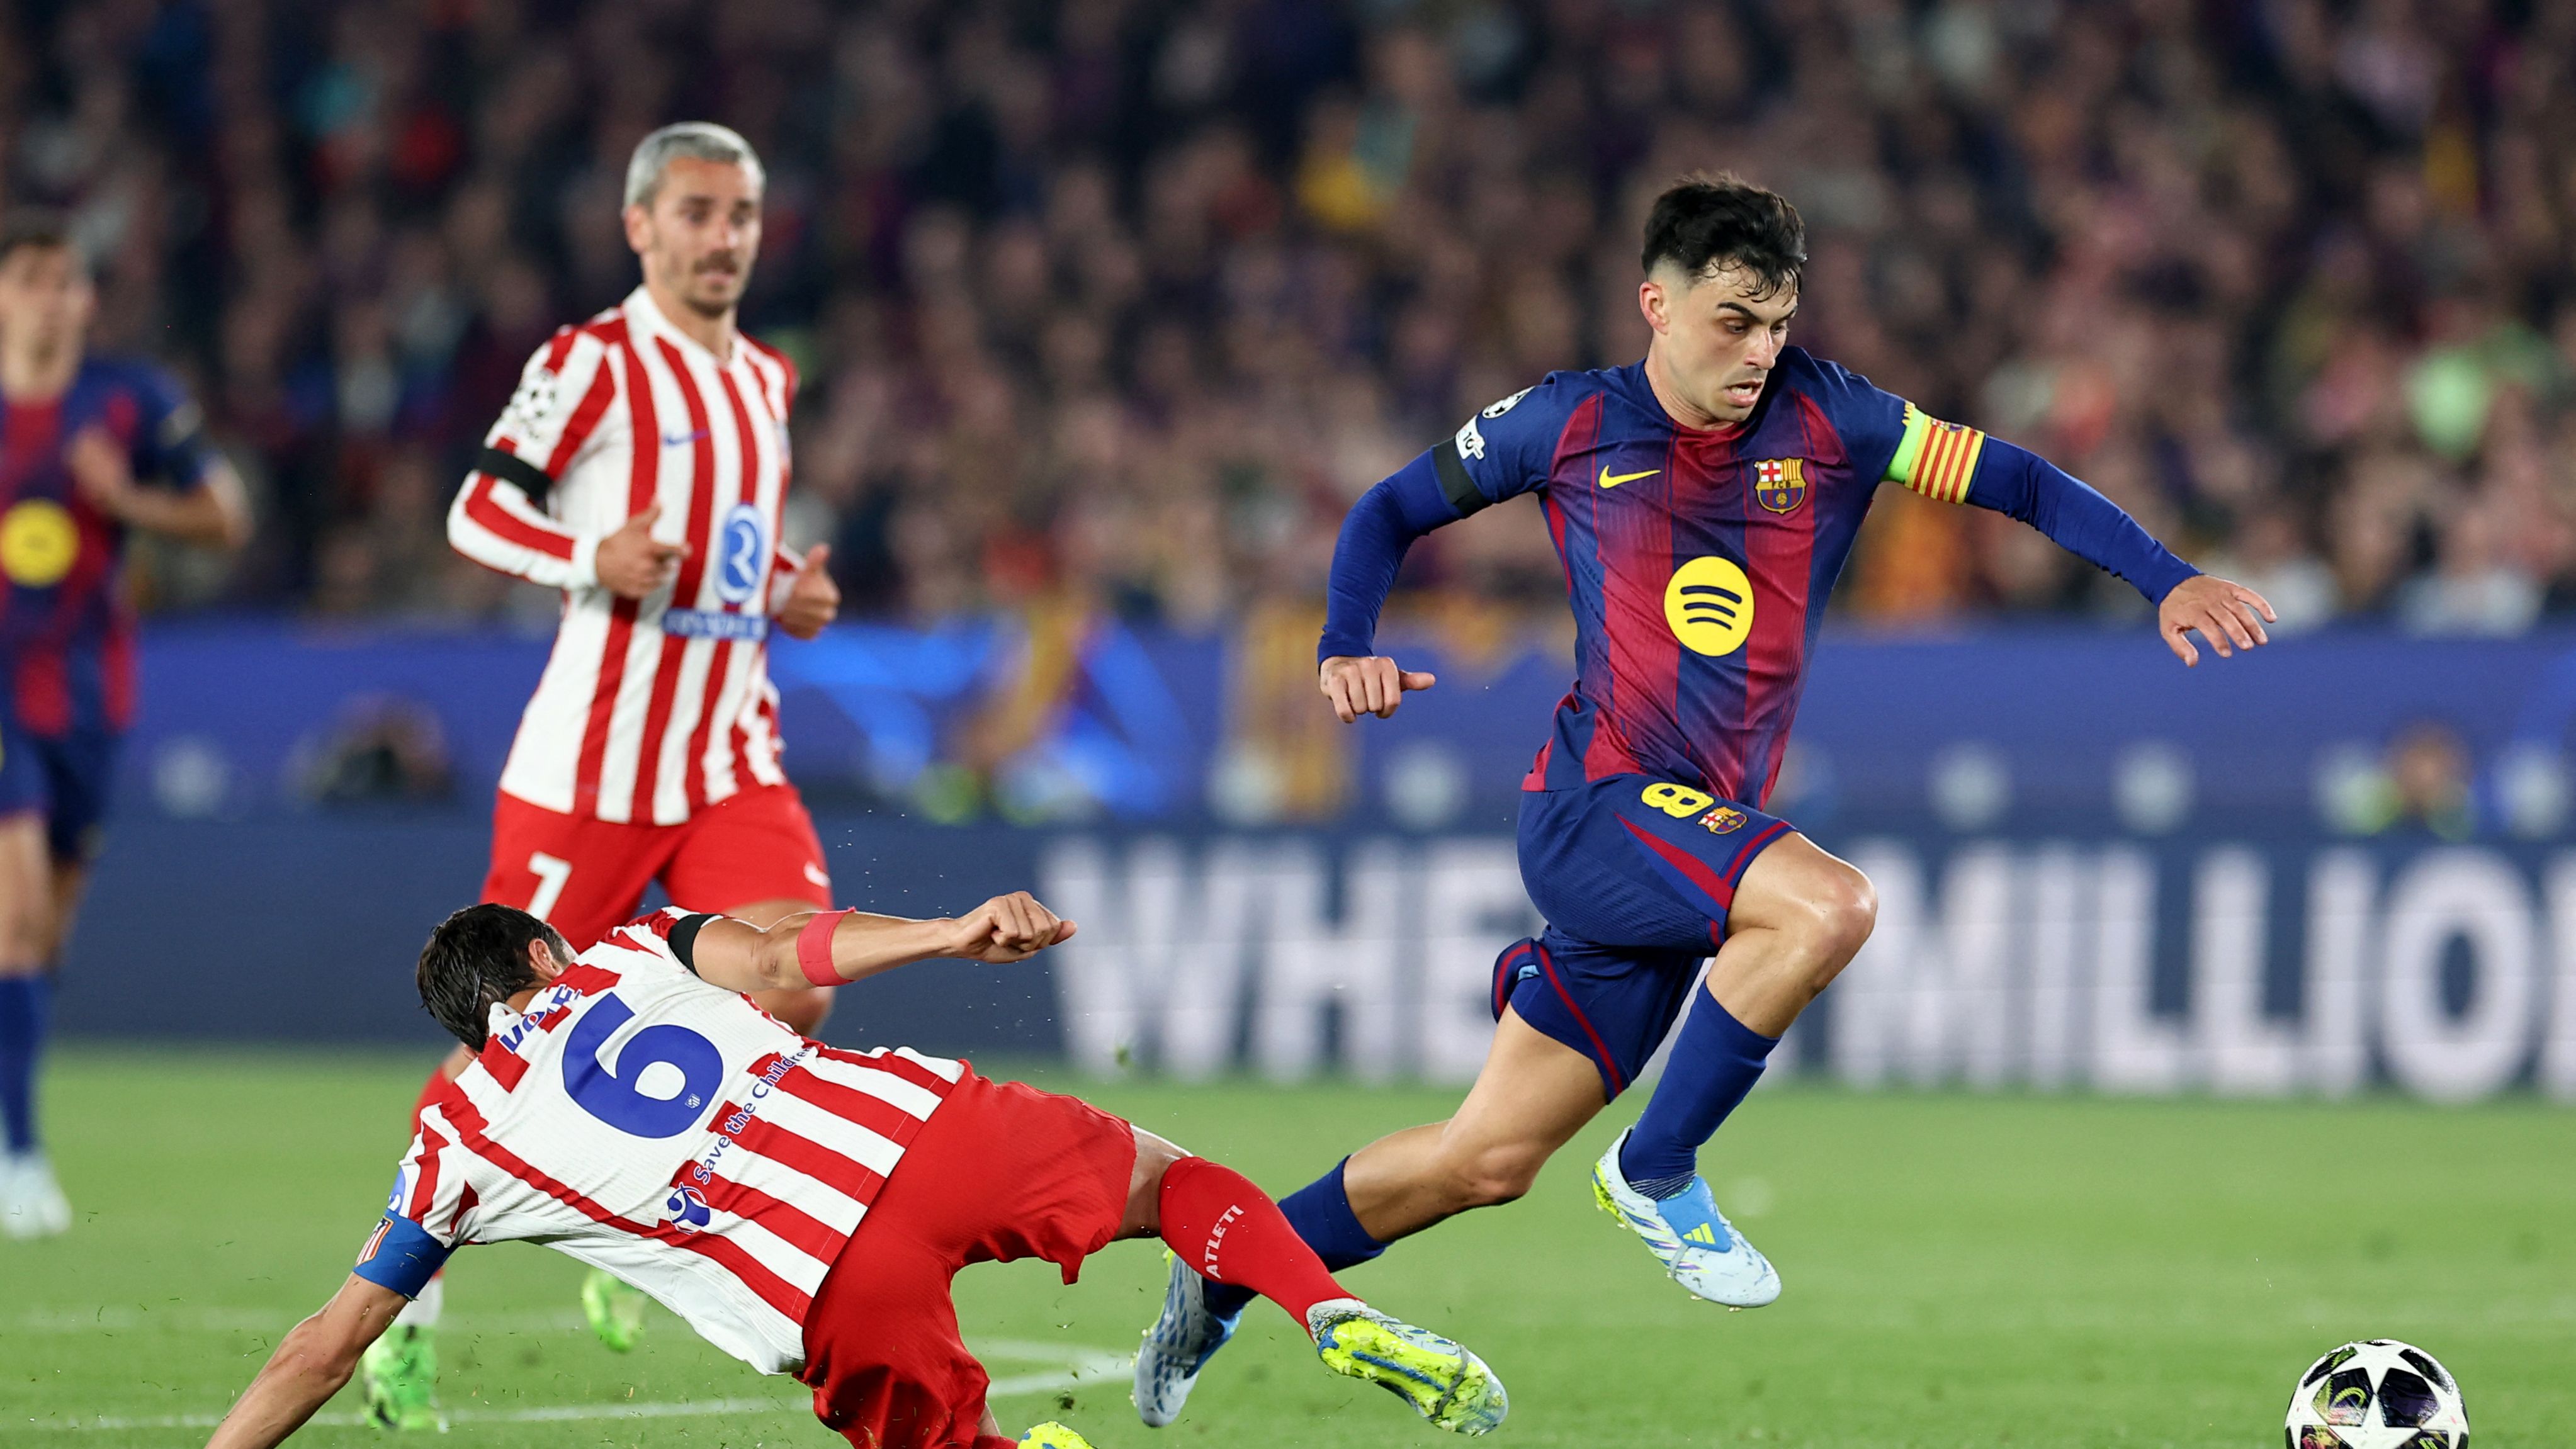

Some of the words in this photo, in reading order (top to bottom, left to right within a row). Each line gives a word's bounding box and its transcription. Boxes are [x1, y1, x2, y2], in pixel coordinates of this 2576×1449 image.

[1641, 782, 1715, 819] 8
[528, 850, 573, 923] 7
[1039, 836, 1788, 1088] WHE
[1822, 837, 2576, 1098] MILLIO
[562, 991, 724, 1139] 6
[693, 1136, 732, 1185] Save
[725, 1102, 757, 1136] the
[752, 1047, 811, 1099] Children
[1204, 1204, 1245, 1280] ATLETI
